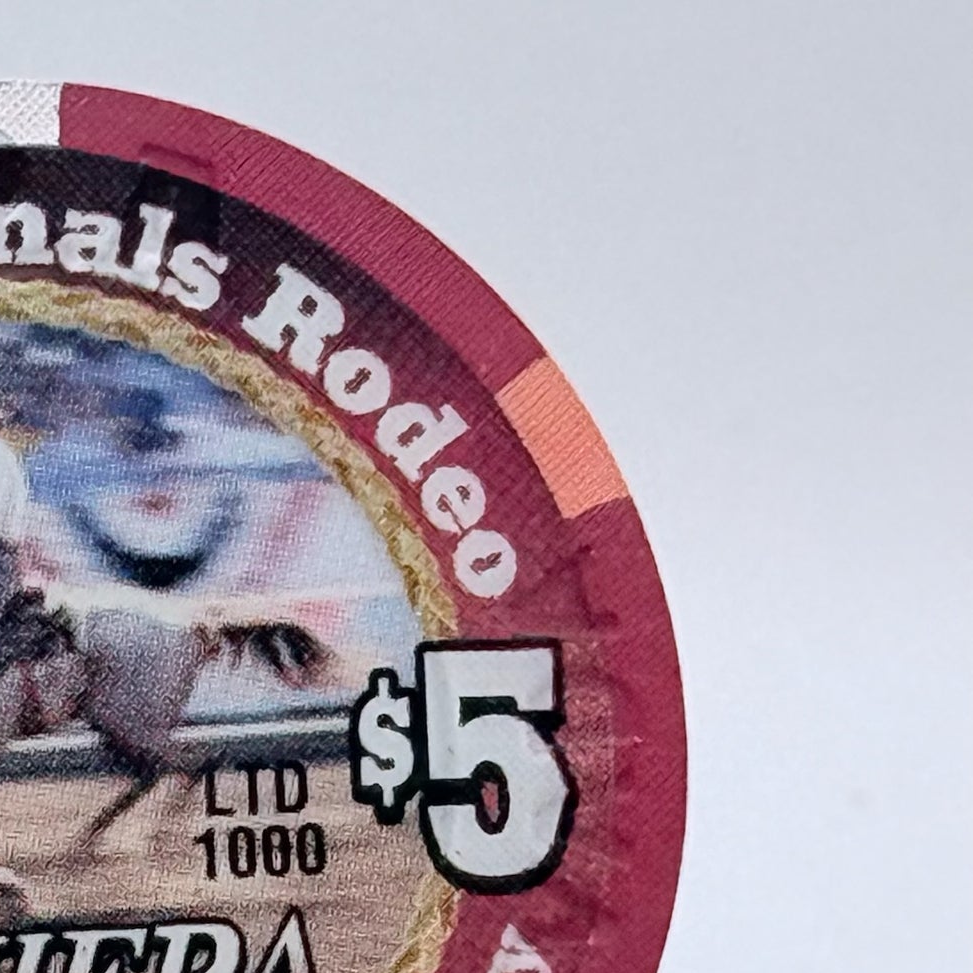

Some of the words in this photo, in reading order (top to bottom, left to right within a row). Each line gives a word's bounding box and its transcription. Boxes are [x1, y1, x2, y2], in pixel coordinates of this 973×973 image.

[242, 263, 517, 598] Rodeo
[205, 761, 308, 817] LTD
[351, 637, 577, 894] $5
[195, 822, 327, 879] 1000
